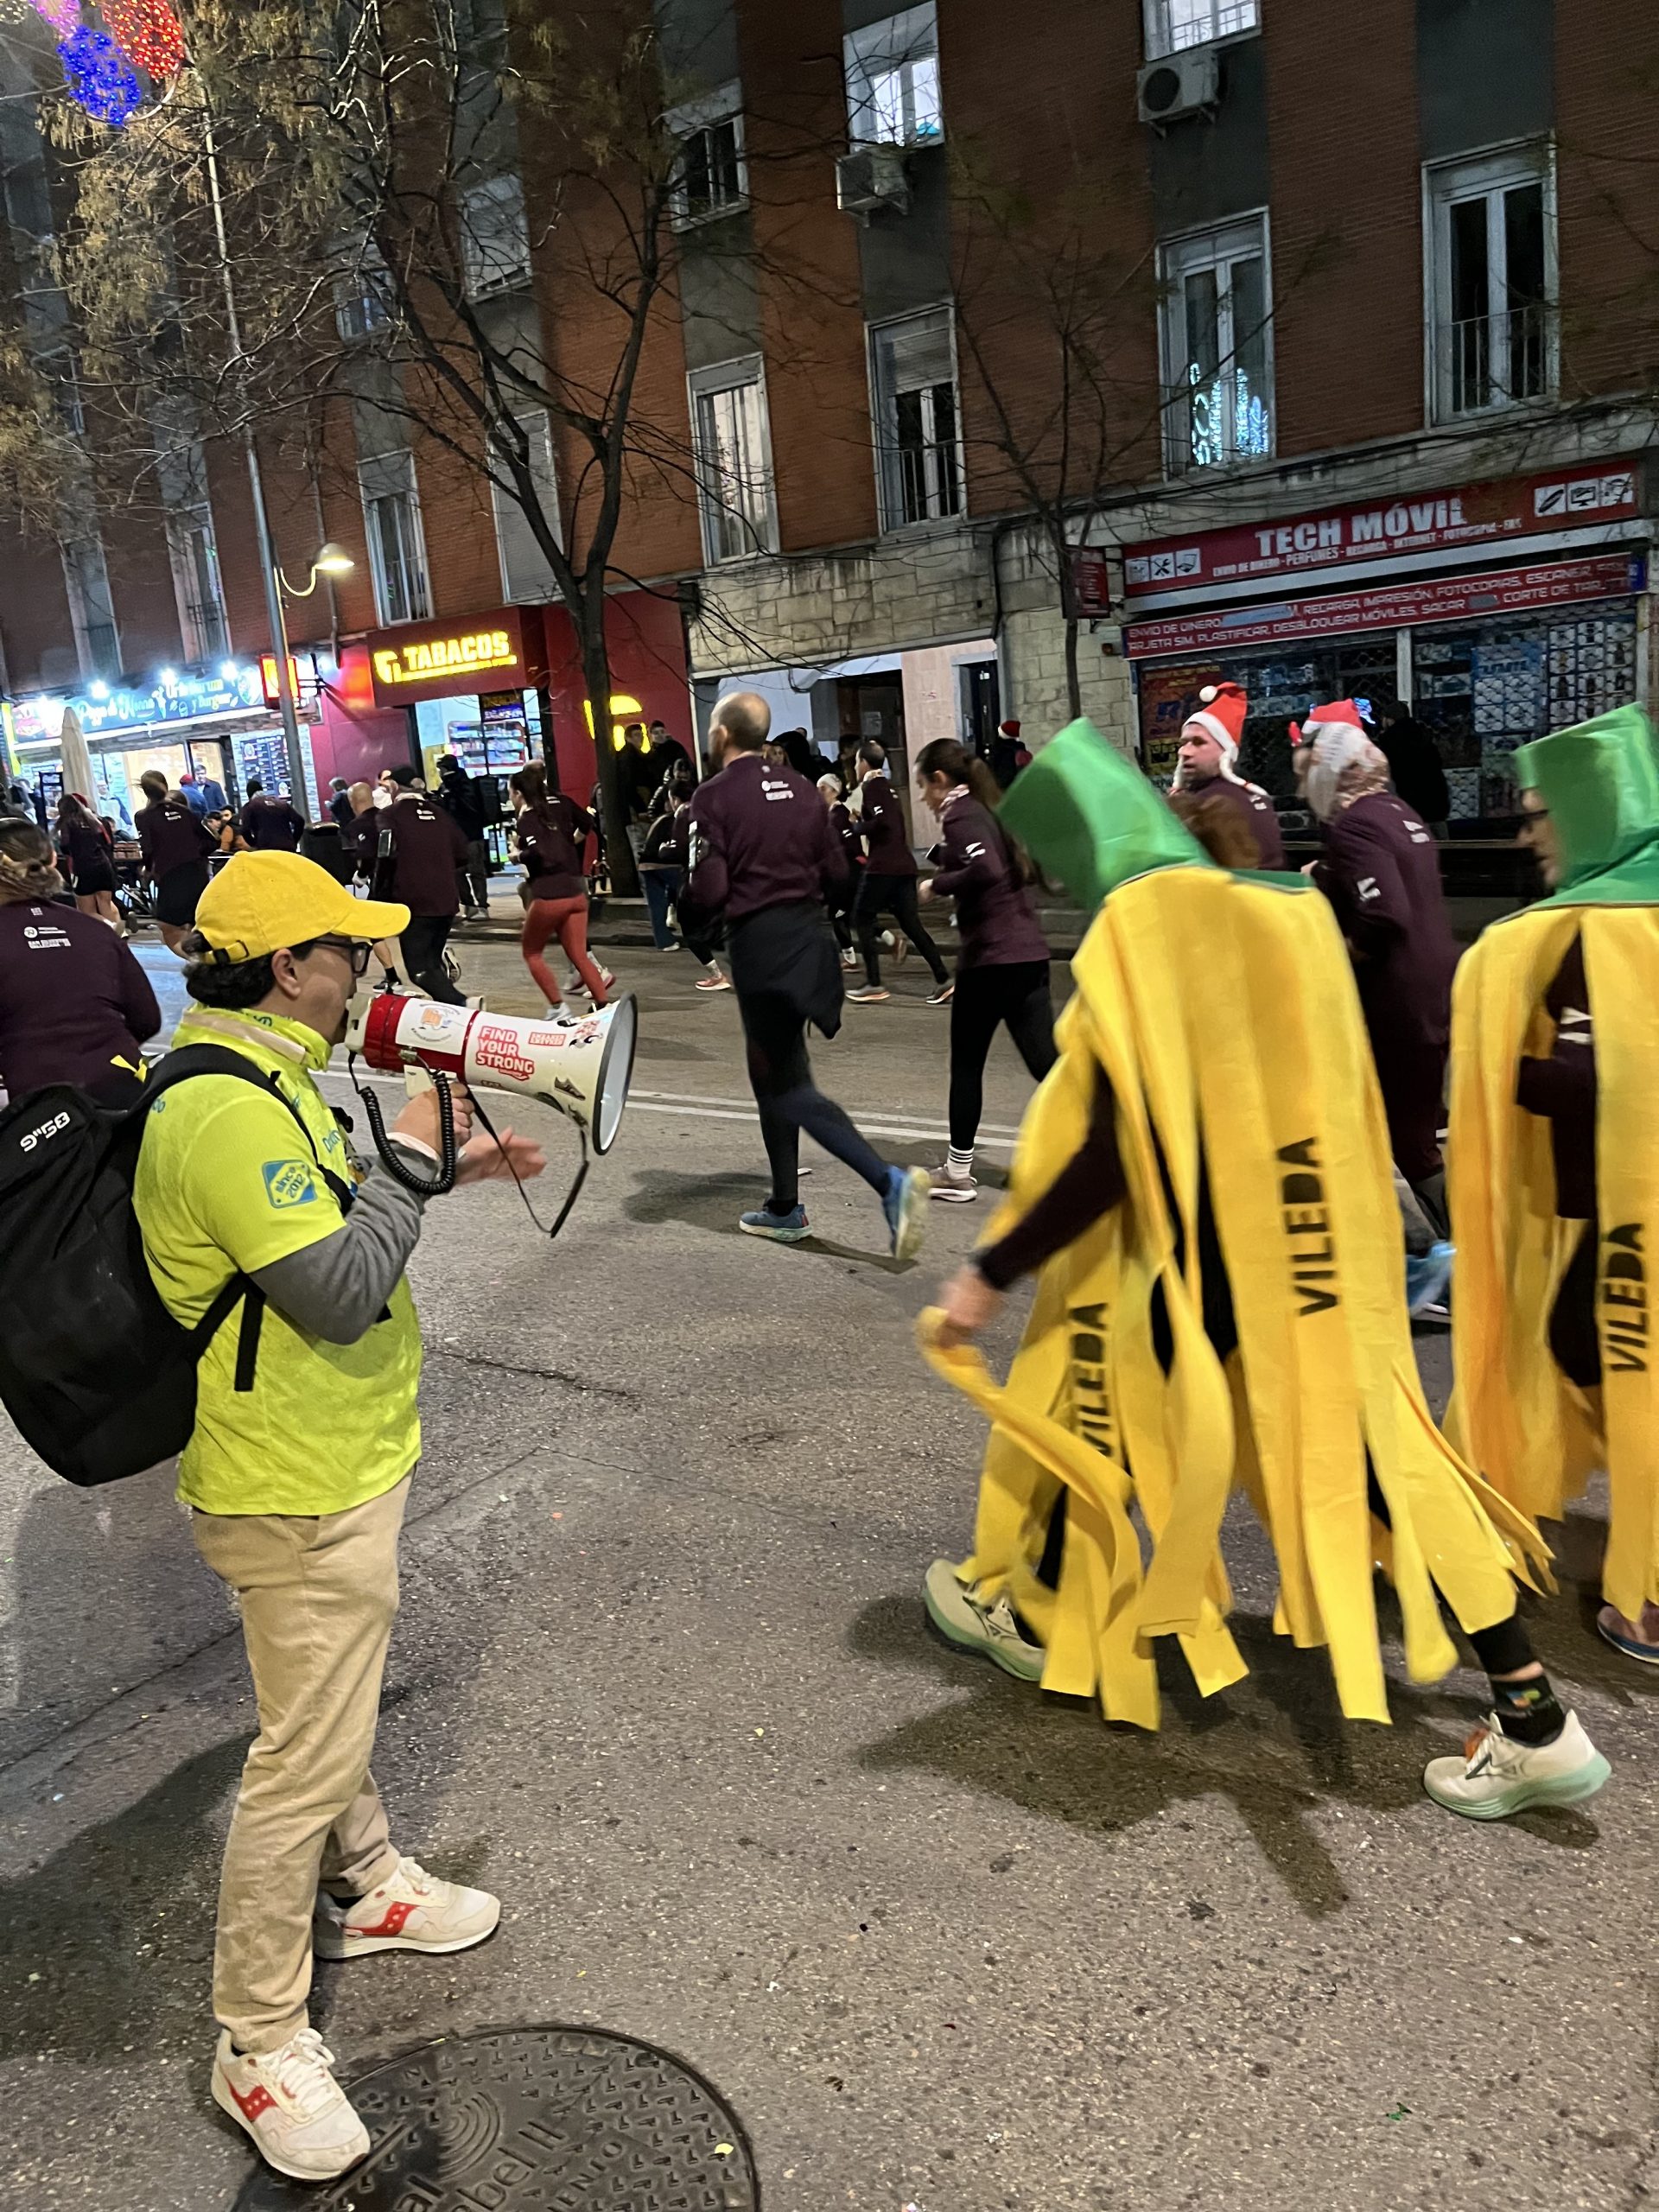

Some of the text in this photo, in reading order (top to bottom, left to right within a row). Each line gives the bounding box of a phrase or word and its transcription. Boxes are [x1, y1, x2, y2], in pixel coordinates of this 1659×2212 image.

[1255, 497, 1467, 556] TECH MÓVIL
[1503, 588, 1548, 603] CORTE
[1551, 584, 1571, 595] DE
[1163, 624, 1178, 634] DE
[1180, 618, 1221, 632] DINERO
[1274, 612, 1359, 633] DESBLOQUEAR
[1421, 600, 1465, 614] SACAR
[403, 630, 511, 671] TABACOS
[479, 1039, 518, 1057] YOUR
[480, 1027, 516, 1042] FIND
[477, 1052, 533, 1073] STRONG
[1276, 1136, 1339, 1316] VILEDA
[1605, 1223, 1646, 1371] VILEDA
[1070, 1303, 1112, 1457] VILEDA
